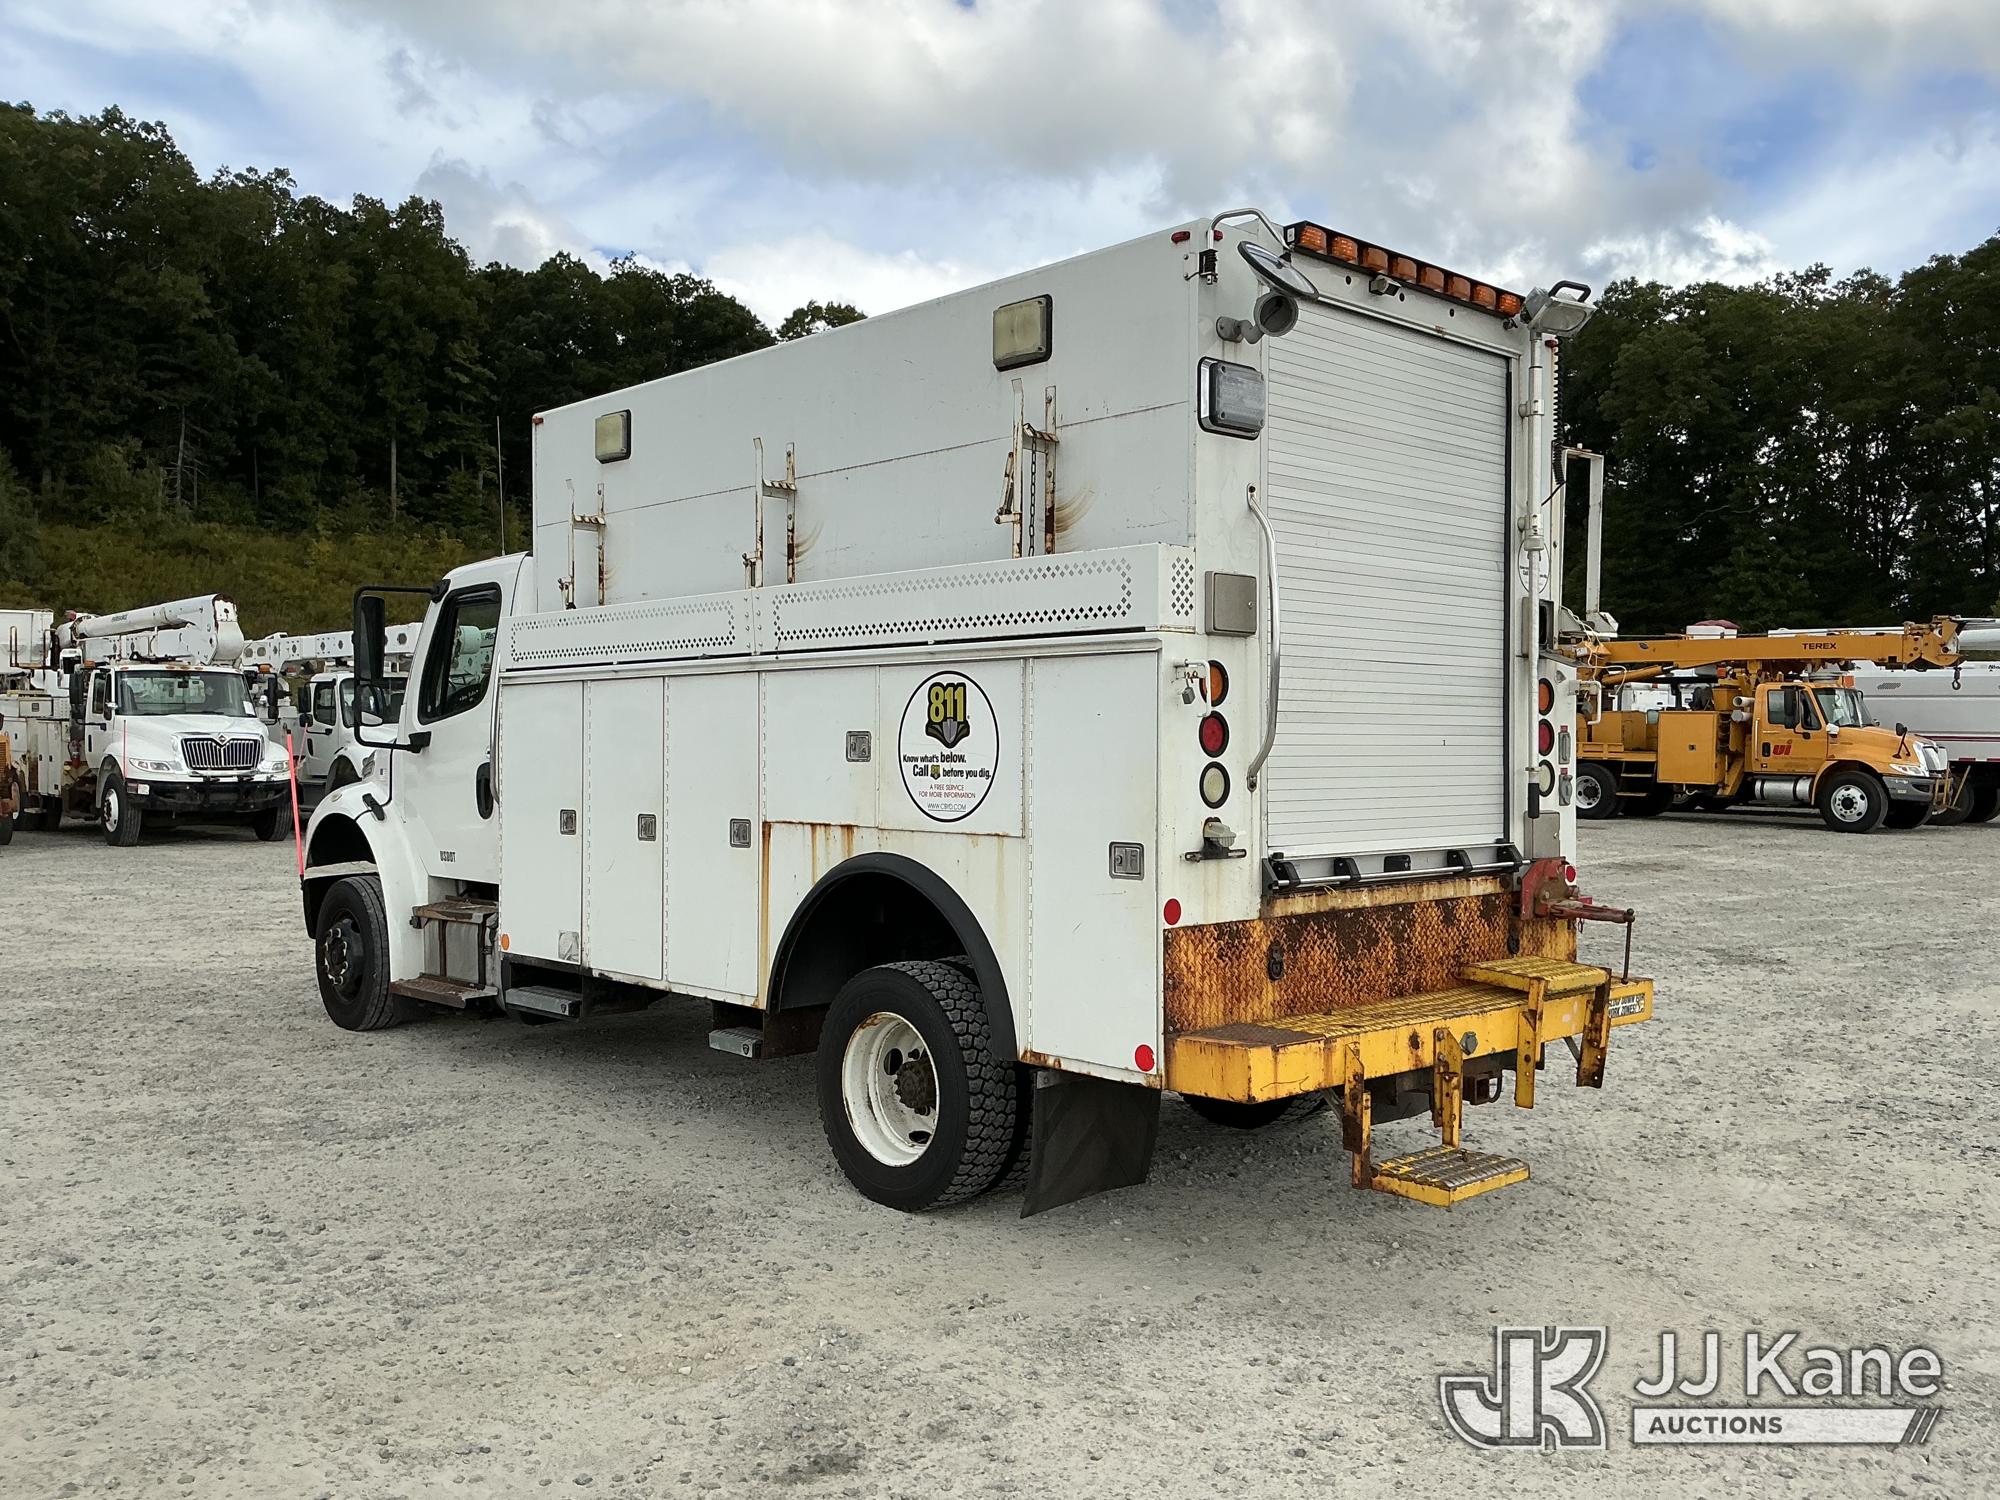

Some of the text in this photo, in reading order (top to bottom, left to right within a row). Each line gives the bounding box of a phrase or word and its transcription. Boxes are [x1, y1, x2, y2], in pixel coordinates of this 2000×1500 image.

[1801, 642, 1837, 650] TEREX
[929, 685, 965, 723] 811
[903, 752, 967, 763] Know what's below.
[912, 764, 929, 777] Call
[942, 767, 964, 778] before
[965, 769, 978, 780] you
[978, 768, 992, 780] dig.
[943, 791, 976, 799] INFORMATION
